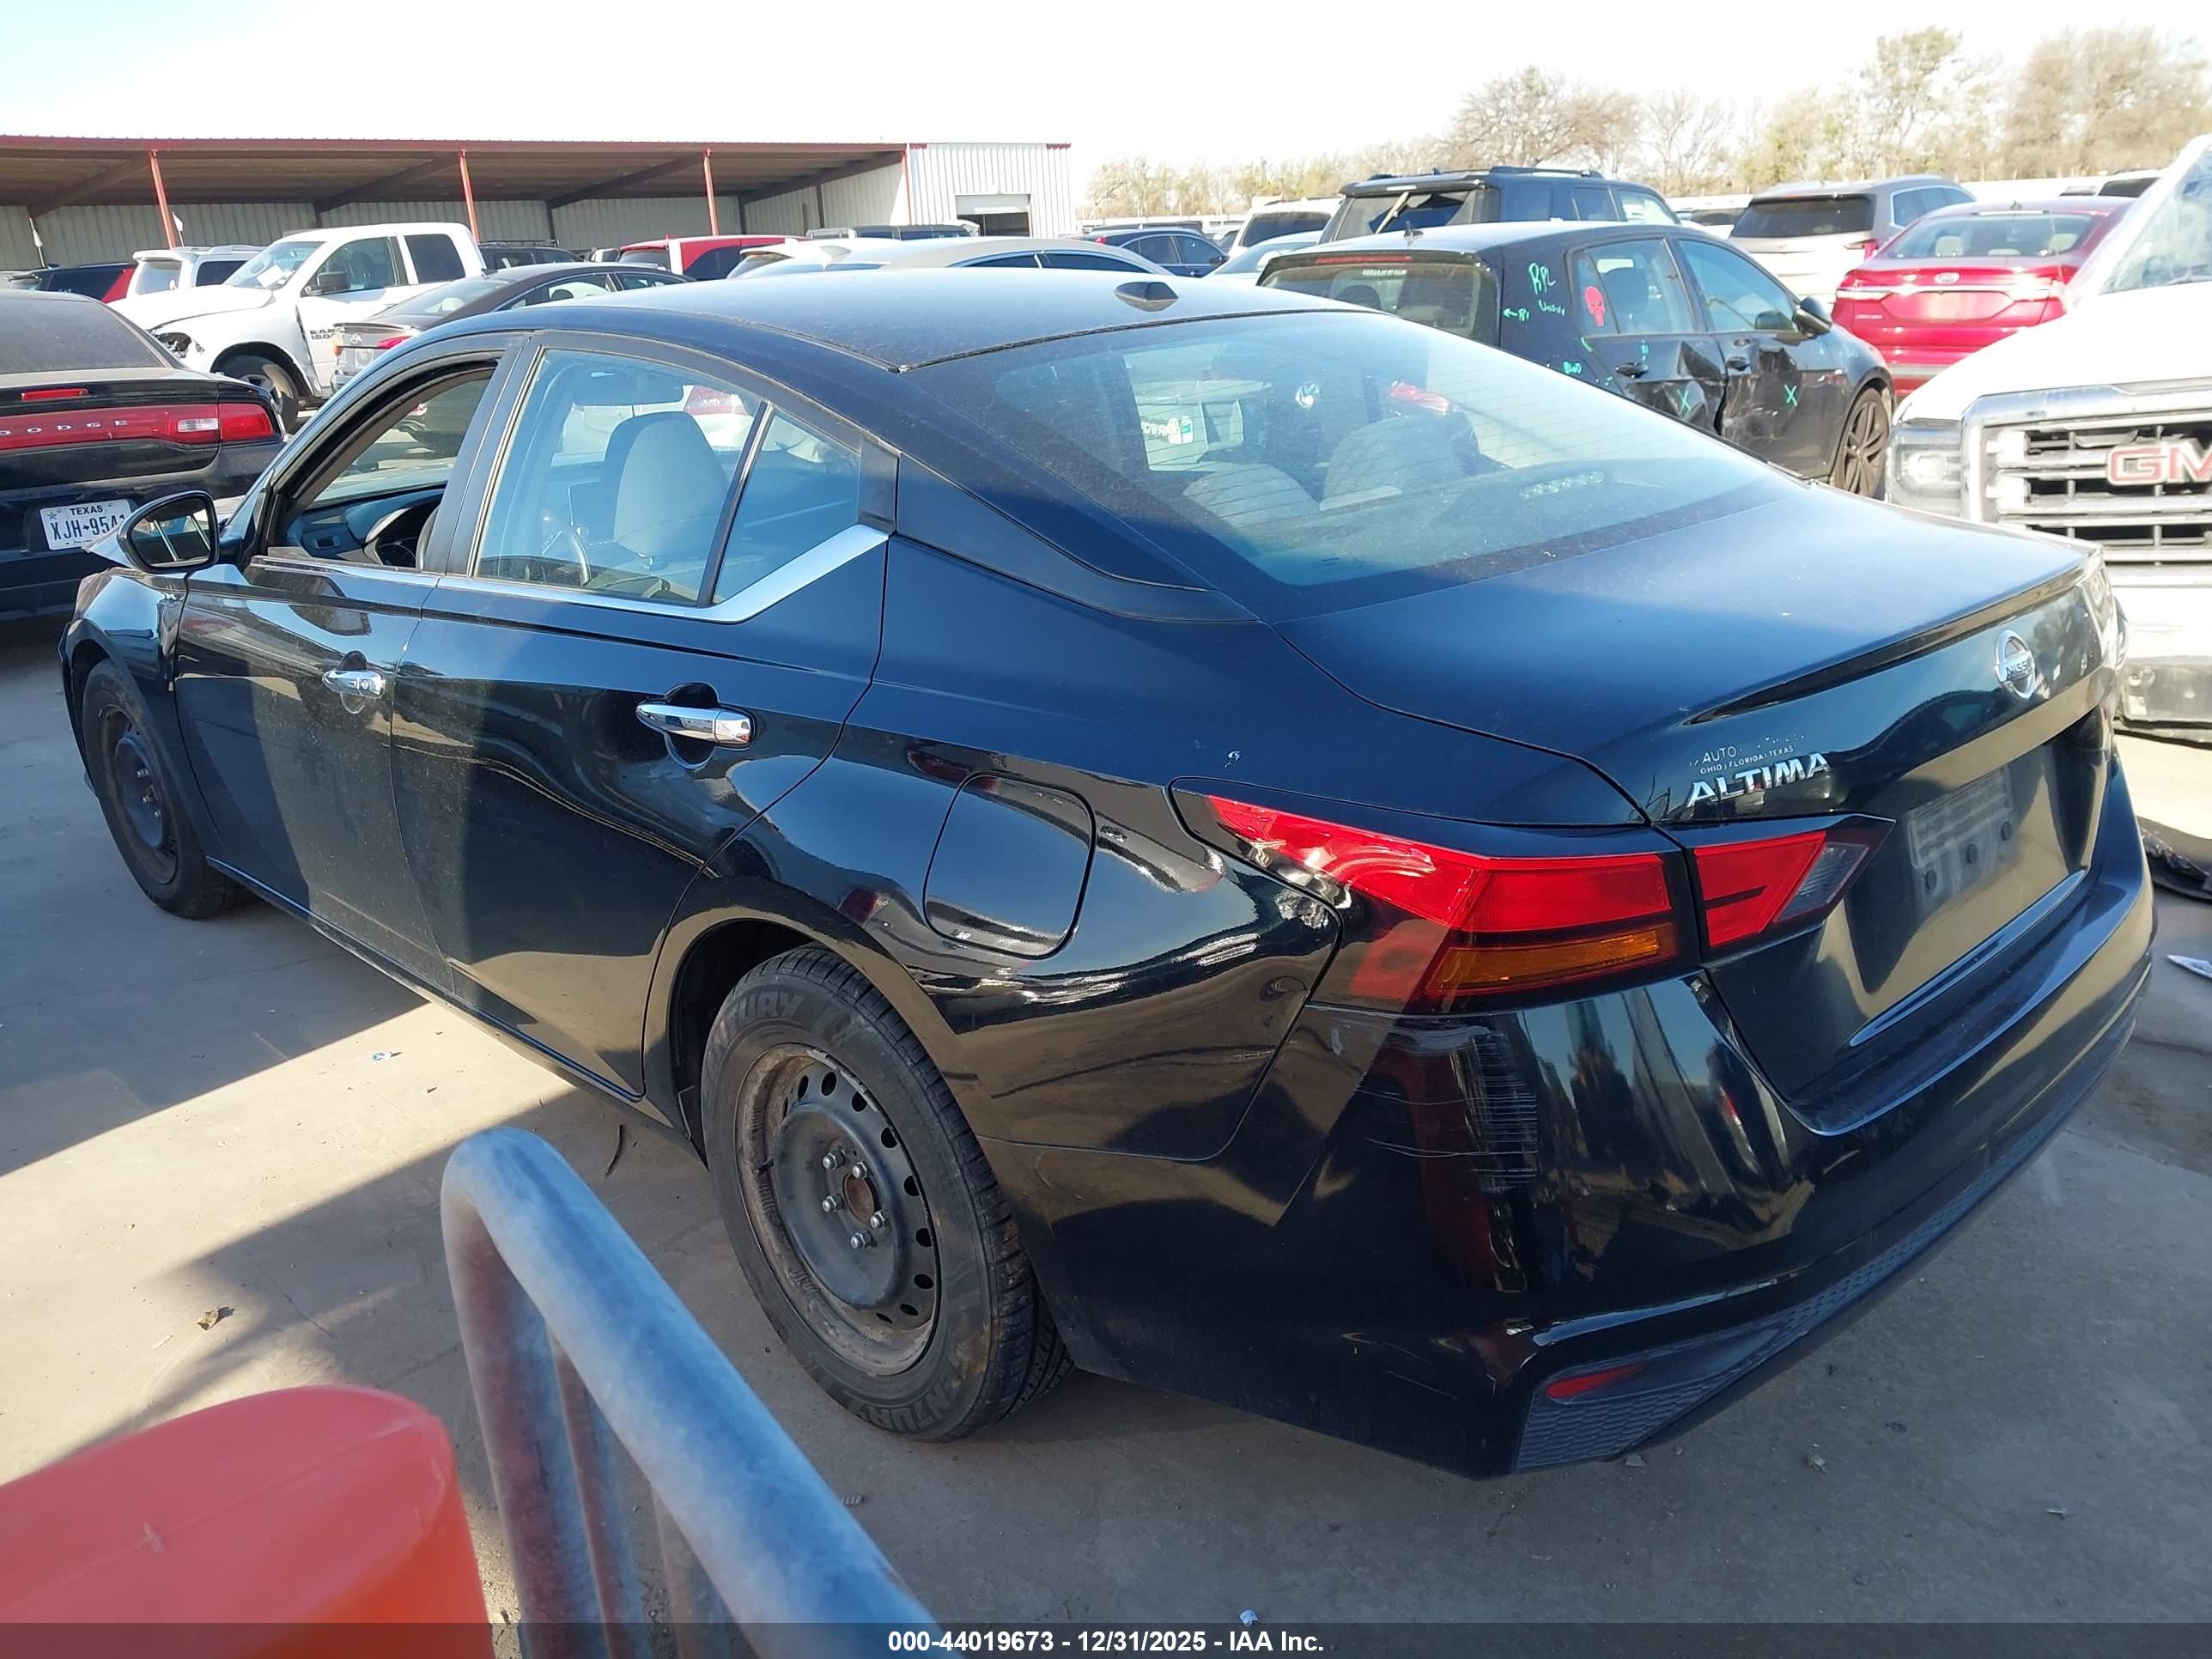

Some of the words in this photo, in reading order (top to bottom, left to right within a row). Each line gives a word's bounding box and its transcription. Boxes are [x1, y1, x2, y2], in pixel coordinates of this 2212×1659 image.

[69, 505, 104, 516] TEXAS
[1699, 763, 1723, 775] OHIO
[1729, 754, 1765, 769] FLORIDA
[1769, 744, 1795, 758] TEXAS
[1702, 745, 1737, 764] AUTO
[1686, 752, 1831, 809] ALTIMA
